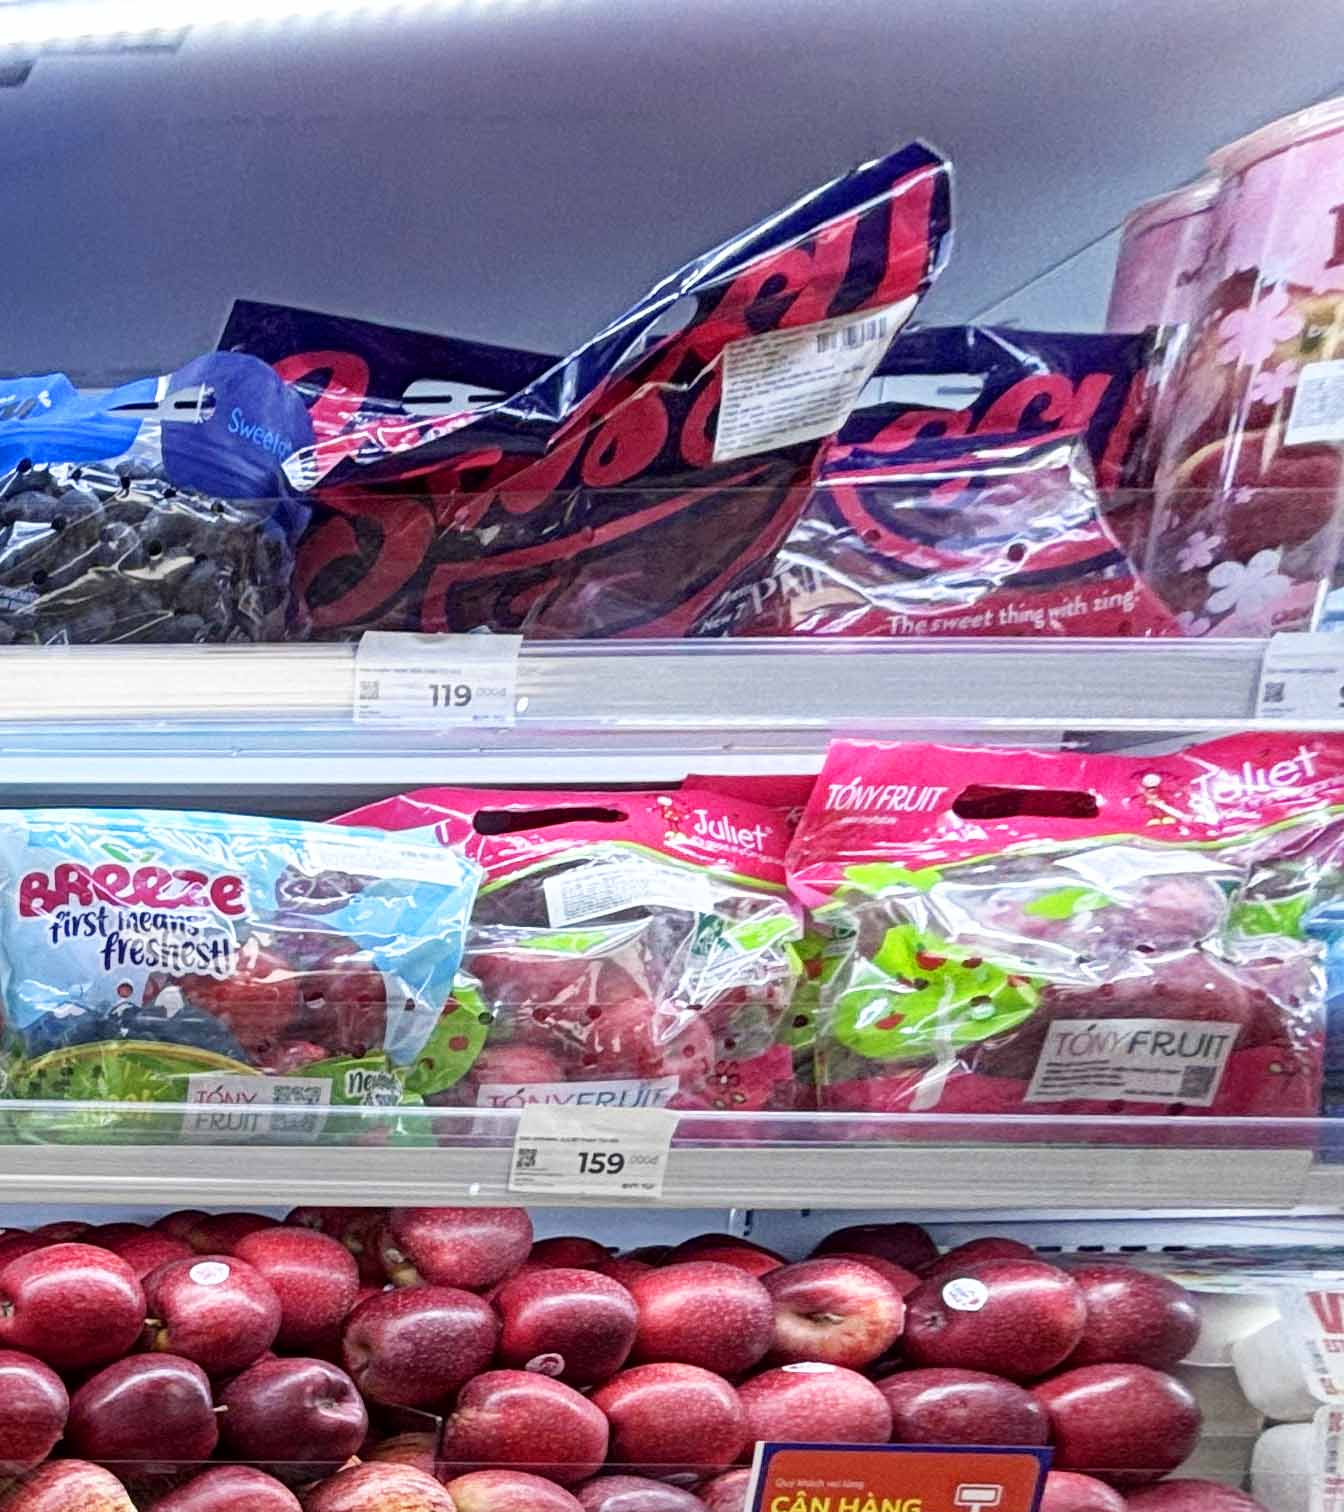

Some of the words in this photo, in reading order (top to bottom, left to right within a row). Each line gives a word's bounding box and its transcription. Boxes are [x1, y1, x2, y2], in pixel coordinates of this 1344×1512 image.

[931, 612, 993, 634] sweet
[998, 603, 1046, 629] thing
[427, 681, 472, 708] 119
[693, 807, 771, 852] Juliet
[49, 906, 108, 944] first
[576, 1150, 625, 1174] 159
